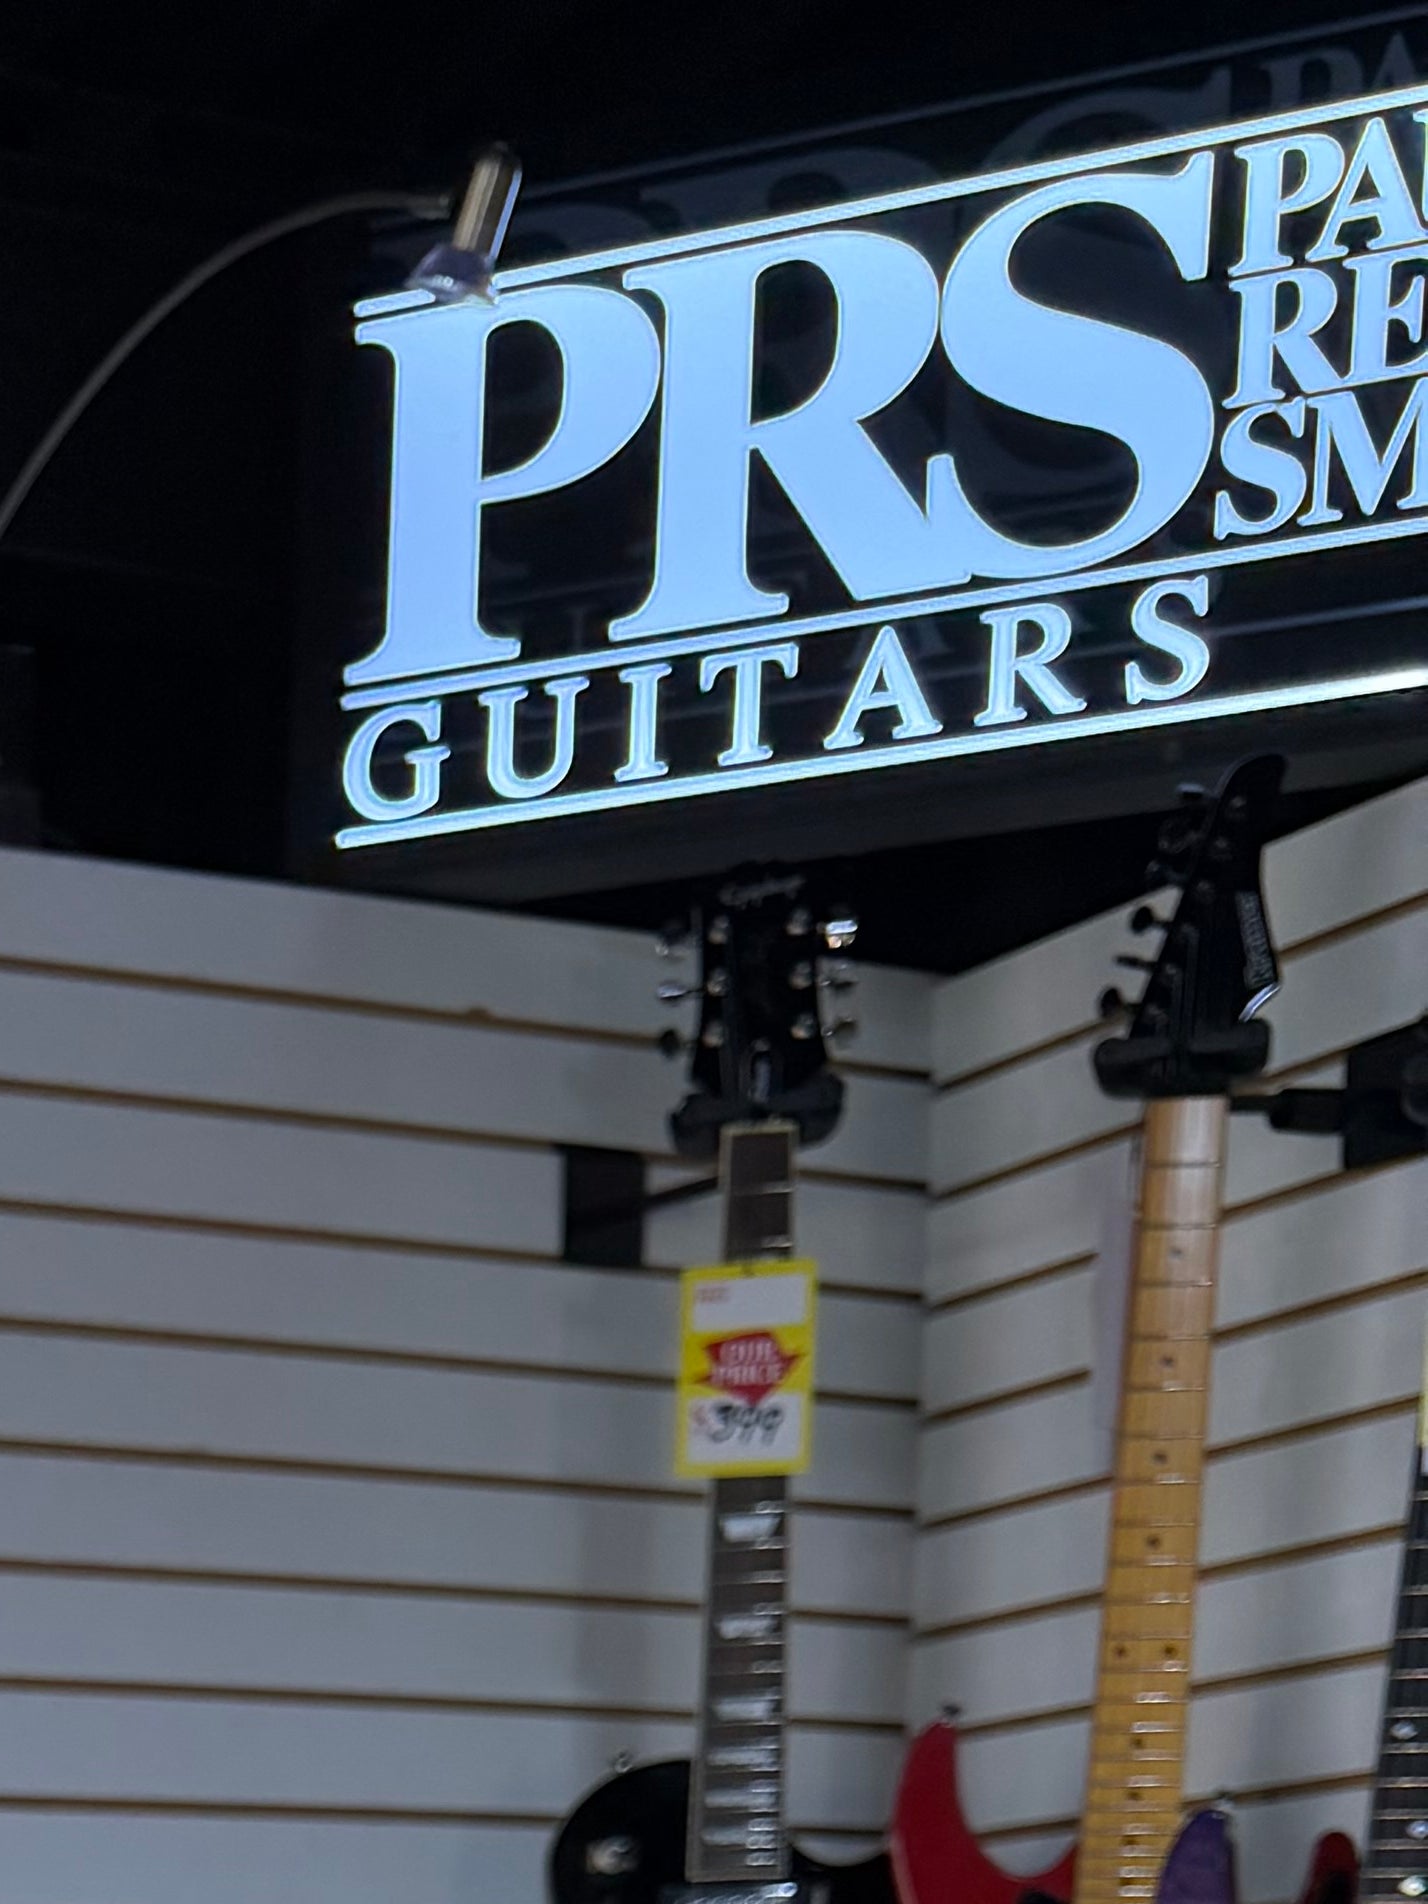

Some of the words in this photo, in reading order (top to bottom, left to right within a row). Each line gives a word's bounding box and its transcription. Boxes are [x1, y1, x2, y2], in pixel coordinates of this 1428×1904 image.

[1228, 108, 1428, 277] PA
[344, 151, 1216, 686] PRS
[343, 575, 1210, 822] GUITARS
